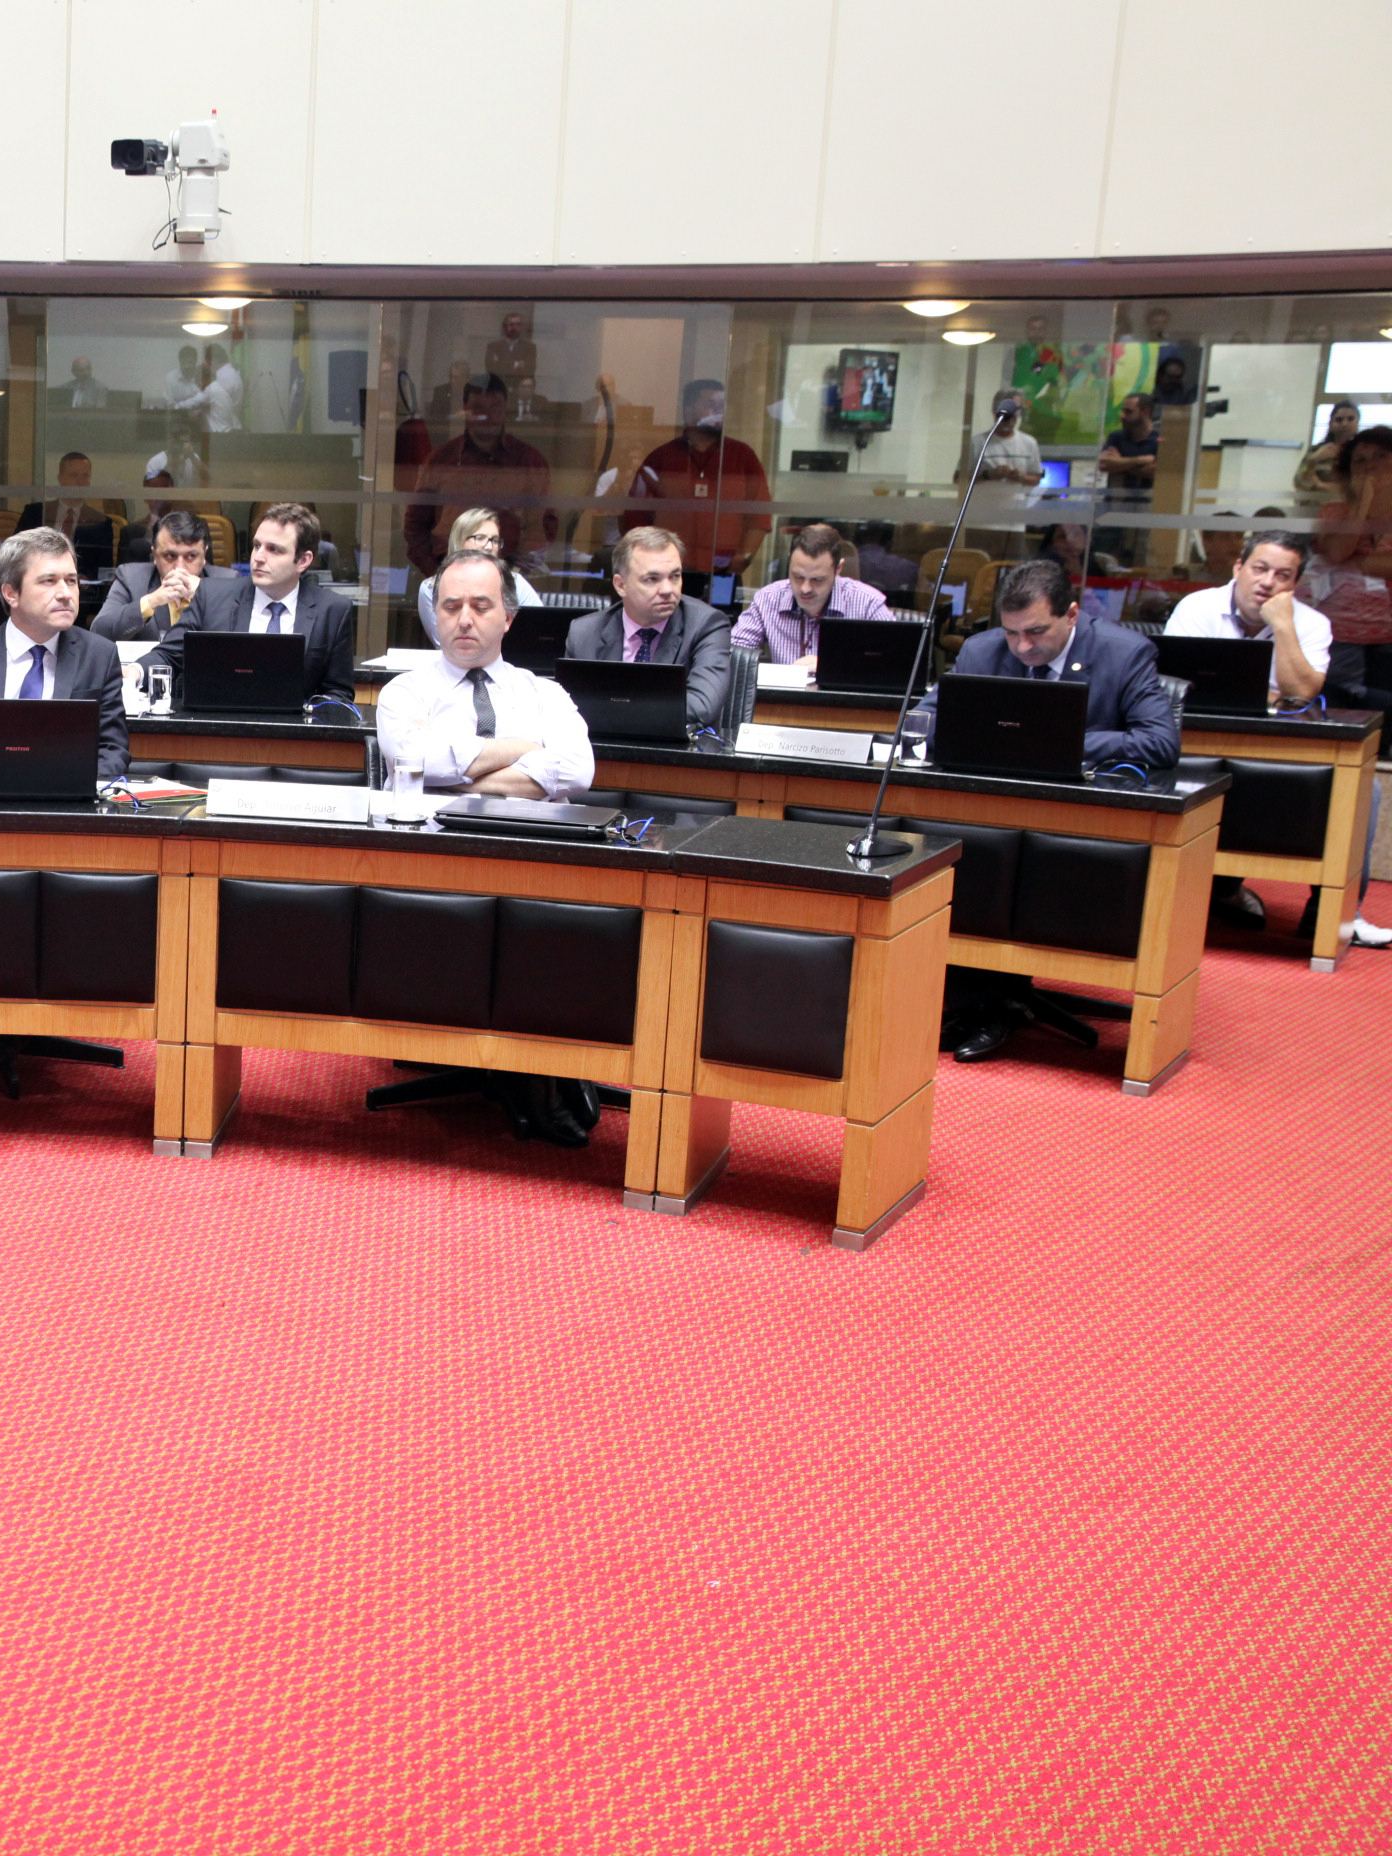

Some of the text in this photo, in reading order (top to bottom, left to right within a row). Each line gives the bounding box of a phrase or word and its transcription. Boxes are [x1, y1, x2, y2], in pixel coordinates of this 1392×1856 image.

[778, 741, 809, 753] Narcizo
[809, 743, 847, 756] Parisotto
[303, 802, 337, 815] Aguiar
